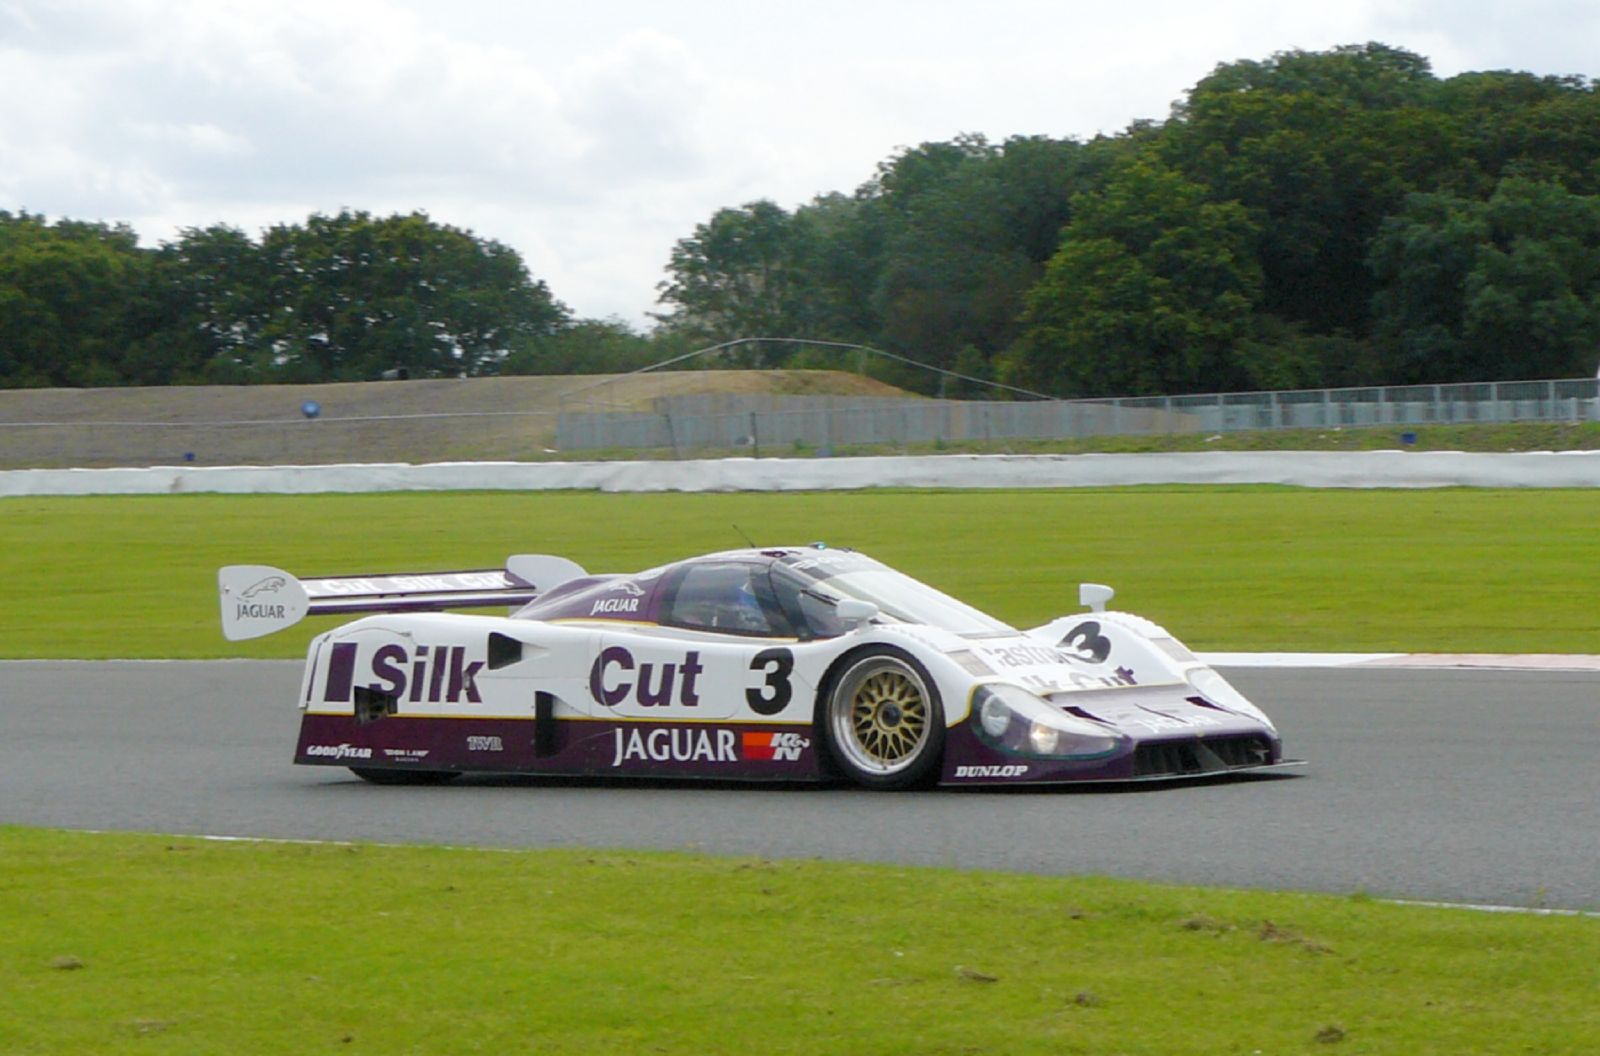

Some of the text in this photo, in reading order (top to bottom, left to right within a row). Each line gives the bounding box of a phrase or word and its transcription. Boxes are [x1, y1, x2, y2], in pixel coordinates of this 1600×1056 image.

[236, 604, 285, 621] JAGUAR
[590, 598, 639, 616] JAGUAR
[1056, 621, 1112, 665] 3
[368, 642, 704, 708] Silk Cut
[744, 647, 795, 716] 3
[306, 743, 373, 759] GOODYEAR
[466, 735, 504, 751] TWR
[611, 727, 738, 767] JAGUAR
[954, 765, 1029, 778] DUNLOP
